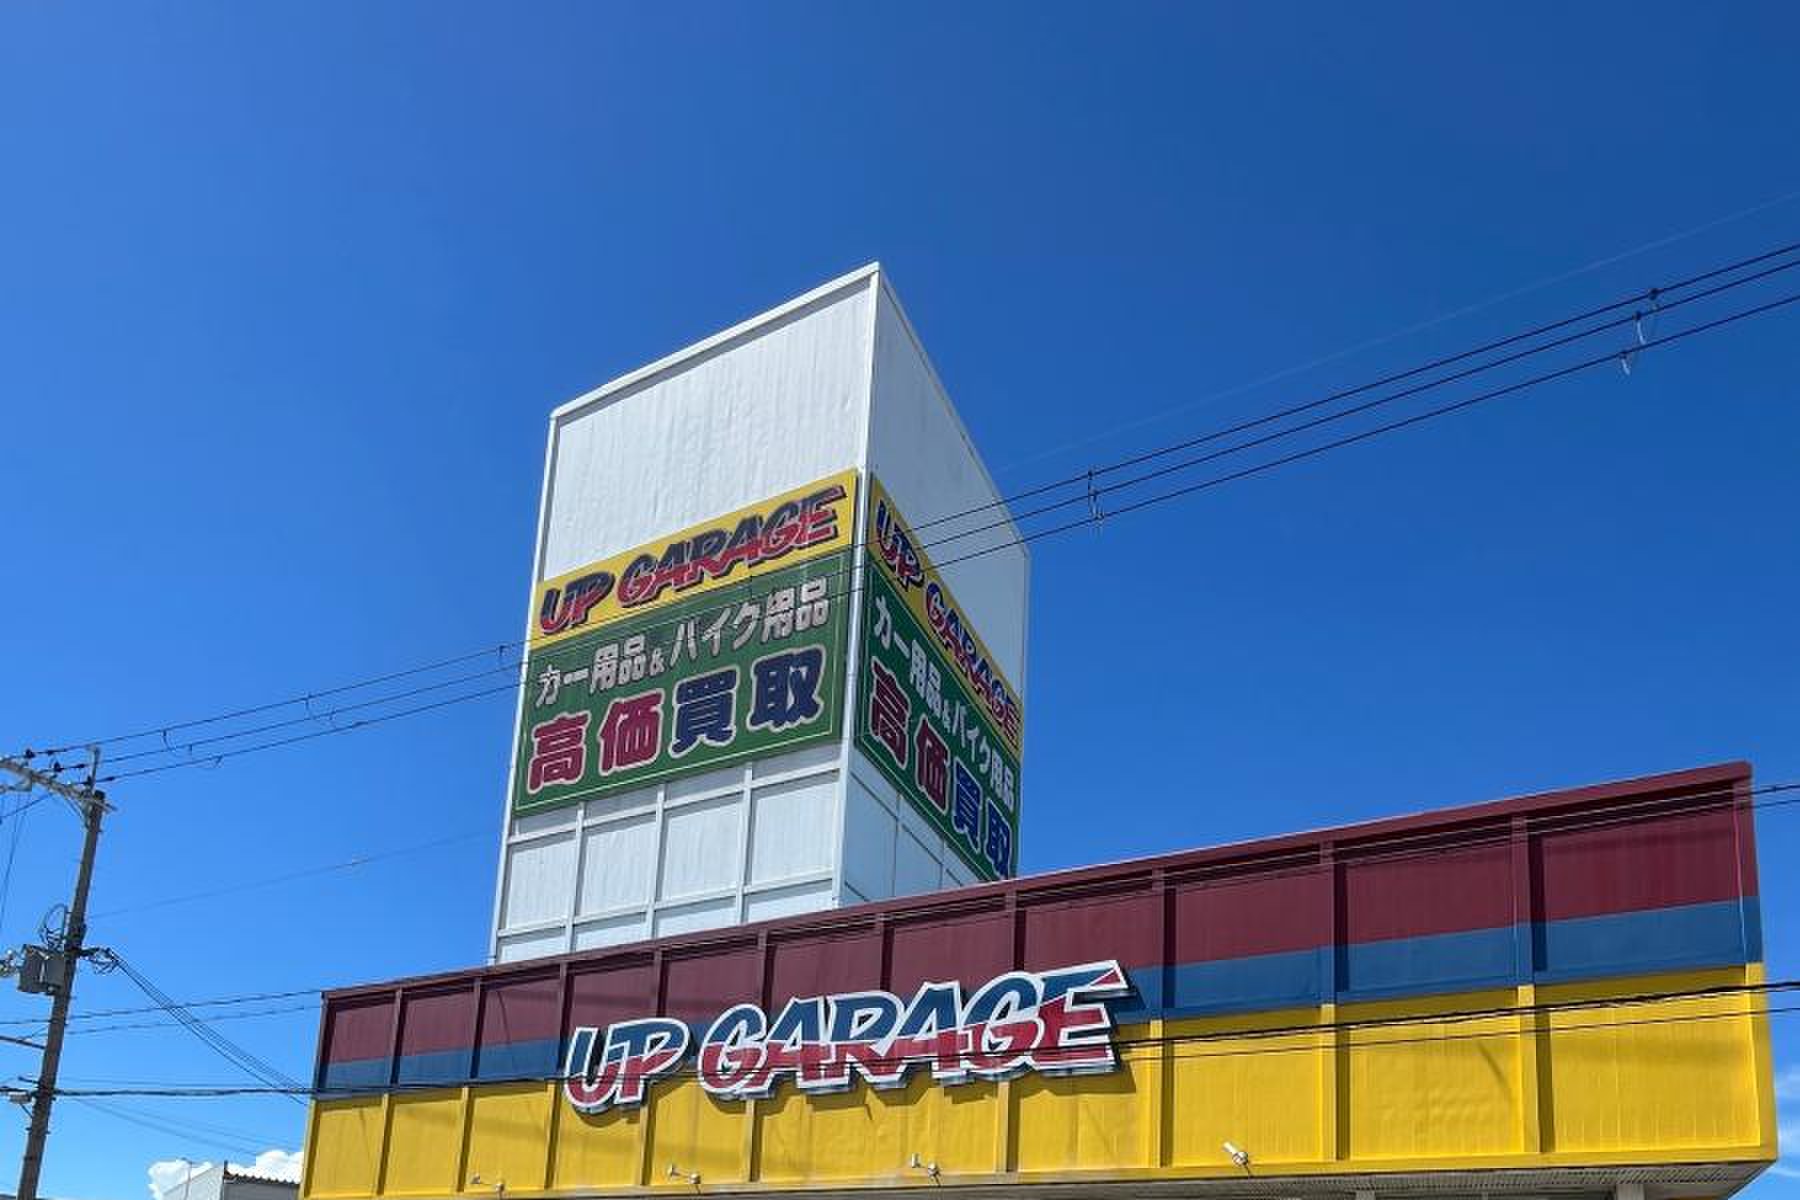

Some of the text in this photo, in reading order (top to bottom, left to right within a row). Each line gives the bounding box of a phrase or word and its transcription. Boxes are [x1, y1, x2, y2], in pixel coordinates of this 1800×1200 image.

[540, 486, 847, 635] UP GARAGE
[876, 500, 1020, 750] UP GARAGE
[536, 577, 829, 707] カー用品&バイク用品
[528, 646, 827, 795] 高価買取
[870, 656, 1012, 879] 高価買取
[563, 960, 1131, 1115] UP GARAGE
